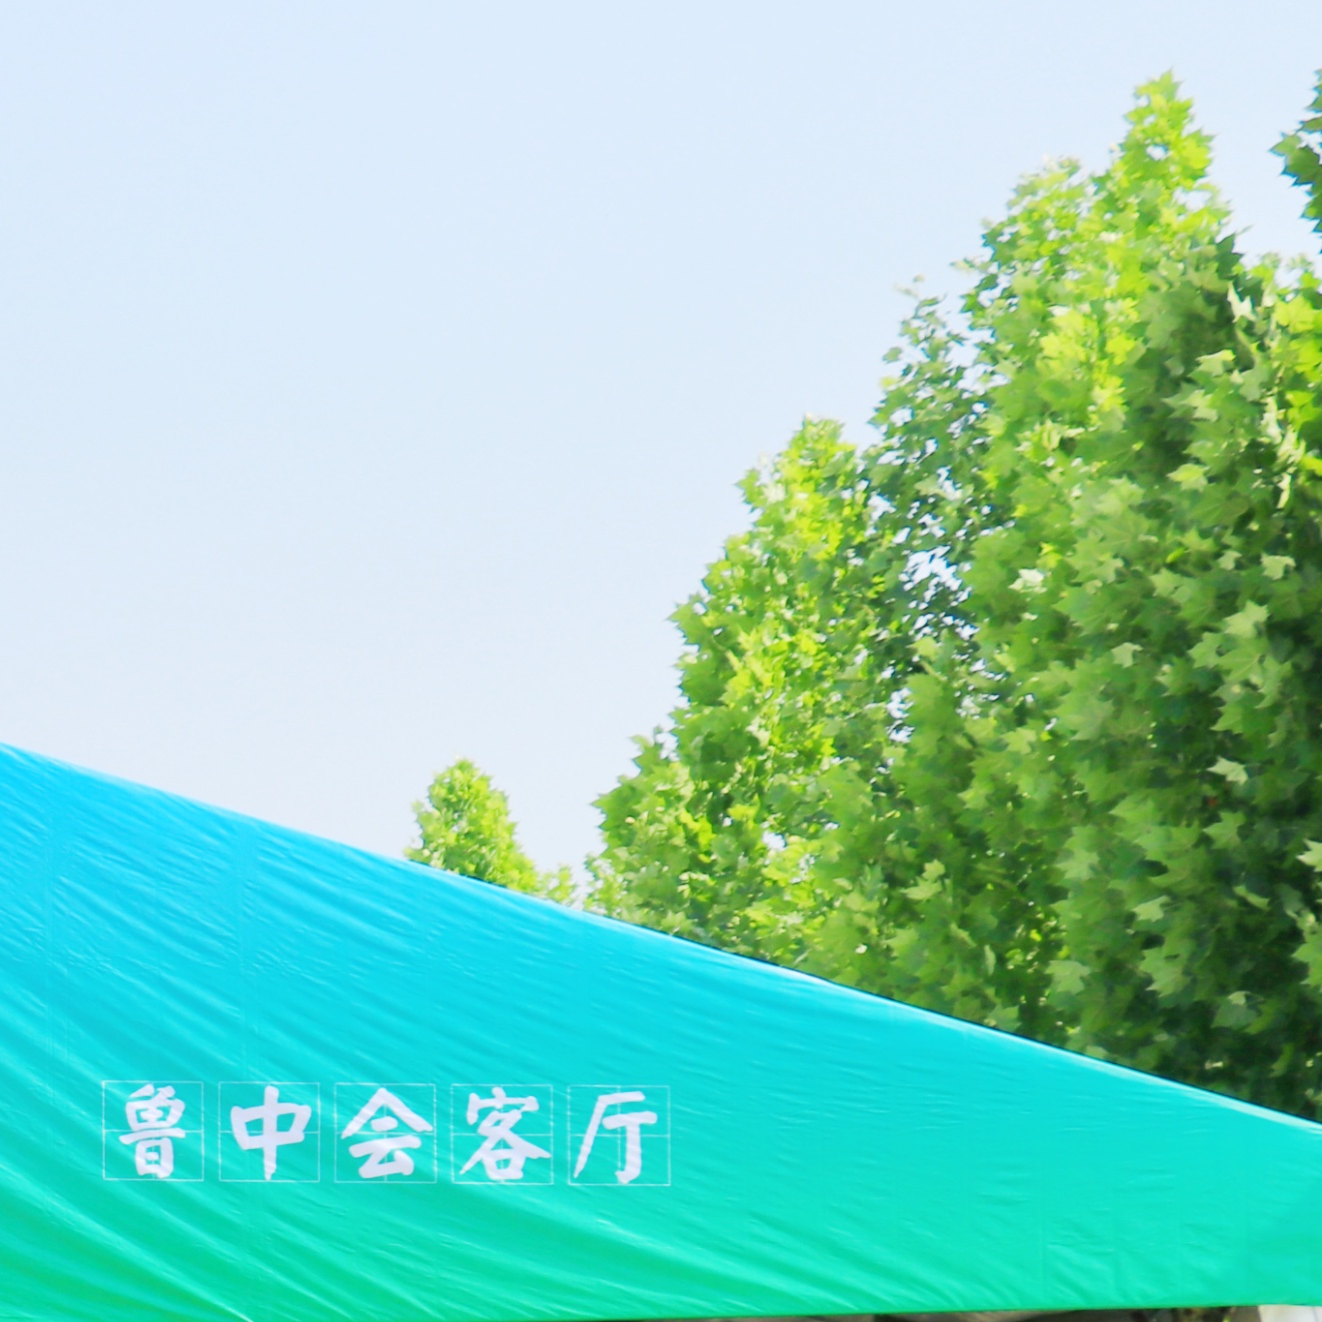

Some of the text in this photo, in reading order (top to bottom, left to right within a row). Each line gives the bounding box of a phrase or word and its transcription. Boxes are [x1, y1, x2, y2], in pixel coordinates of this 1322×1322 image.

[118, 1083, 659, 1185] 鲁中会客厅
